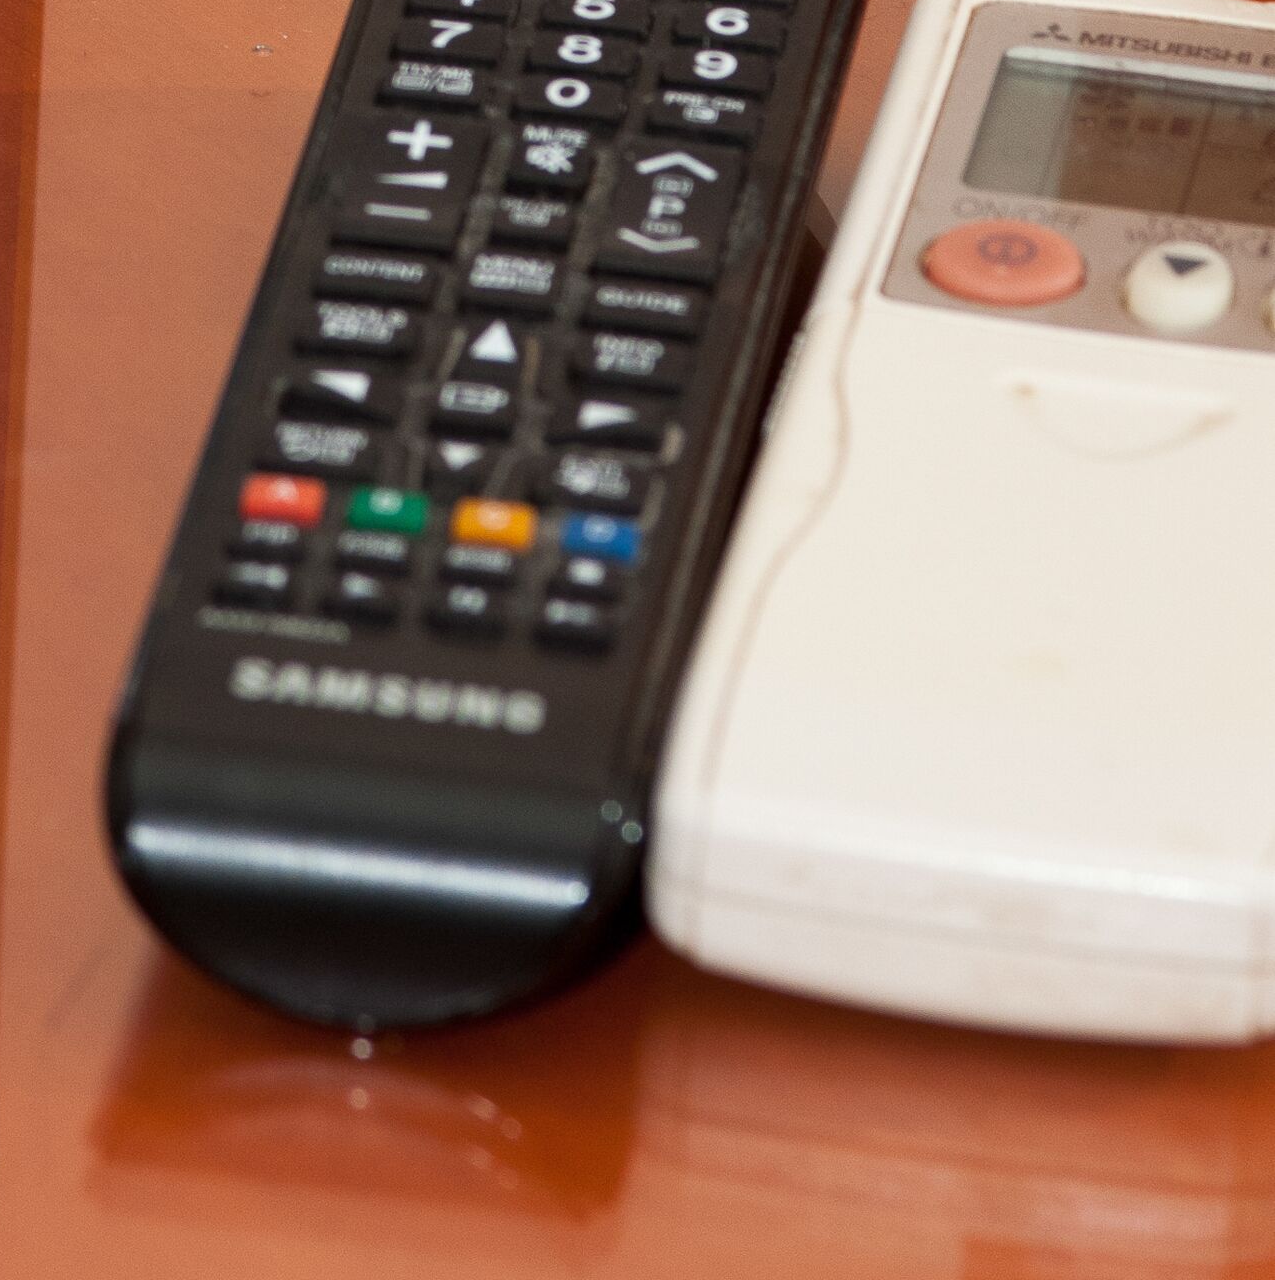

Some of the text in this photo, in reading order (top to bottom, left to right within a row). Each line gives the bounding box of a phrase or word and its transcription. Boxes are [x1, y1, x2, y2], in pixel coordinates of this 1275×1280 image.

[429, 19, 473, 48] 7
[706, 7, 750, 36] 6
[558, 34, 603, 64] 8
[1079, 31, 1253, 65] MITSUBISHI
[693, 50, 738, 80] 9
[648, 195, 686, 219] P
[230, 656, 547, 734] SAMSUNG
